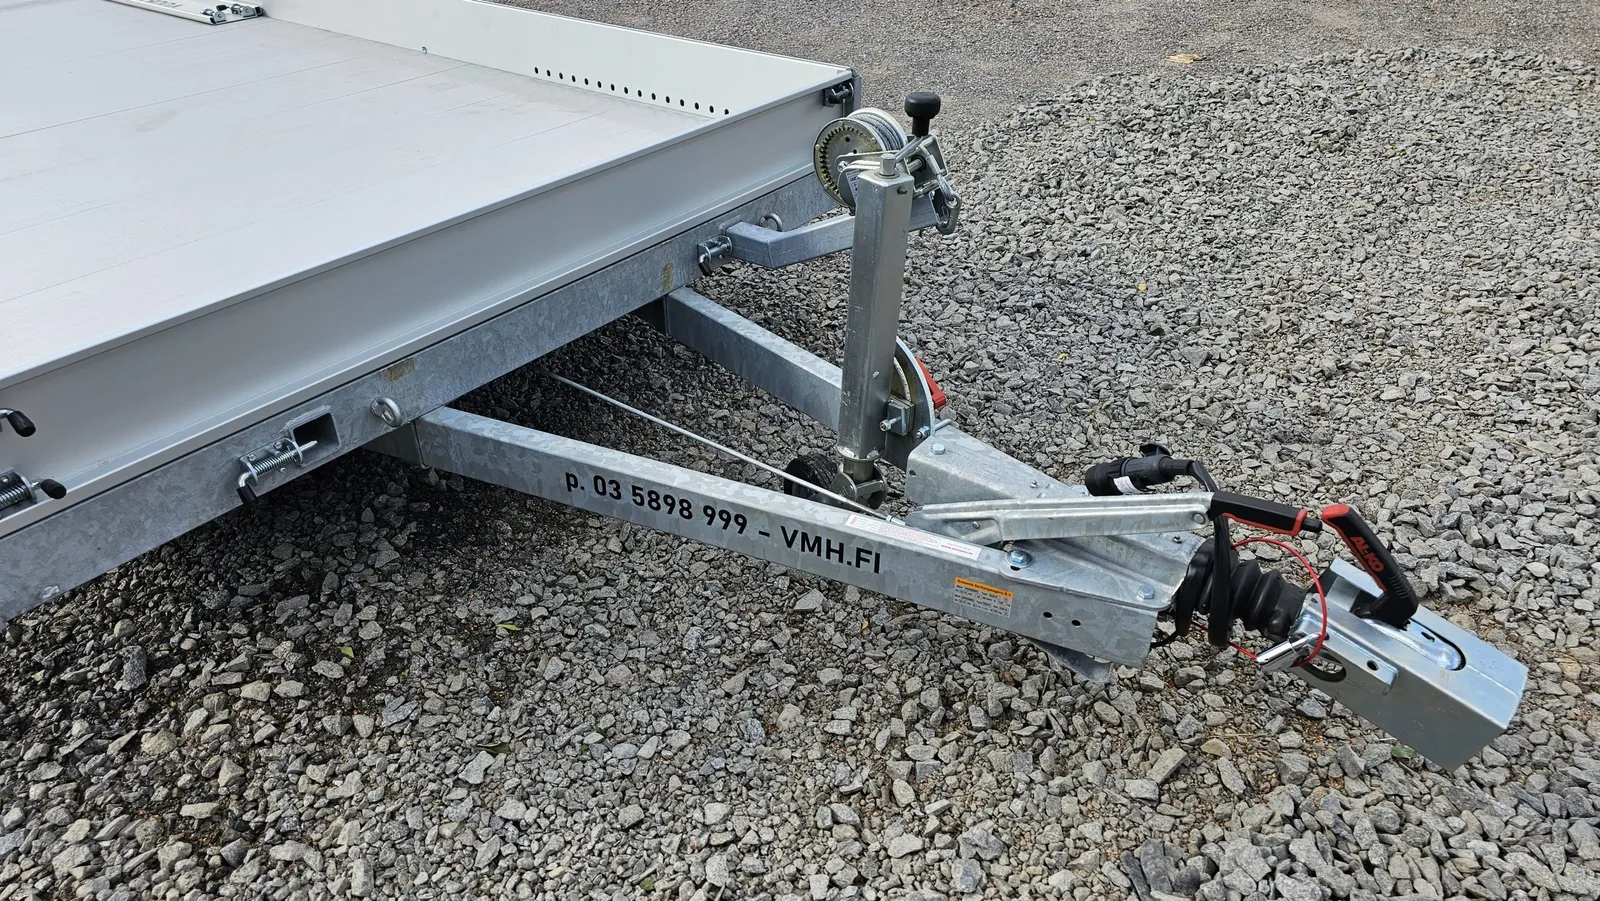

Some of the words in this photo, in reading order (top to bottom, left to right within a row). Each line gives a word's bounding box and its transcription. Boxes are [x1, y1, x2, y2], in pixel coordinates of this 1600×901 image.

[565, 471, 589, 493] p.
[593, 474, 622, 501] 03
[631, 485, 693, 520] 5898
[702, 505, 748, 535] 999
[780, 525, 881, 575] VMH.FI
[1349, 537, 1385, 572] AL-KO
